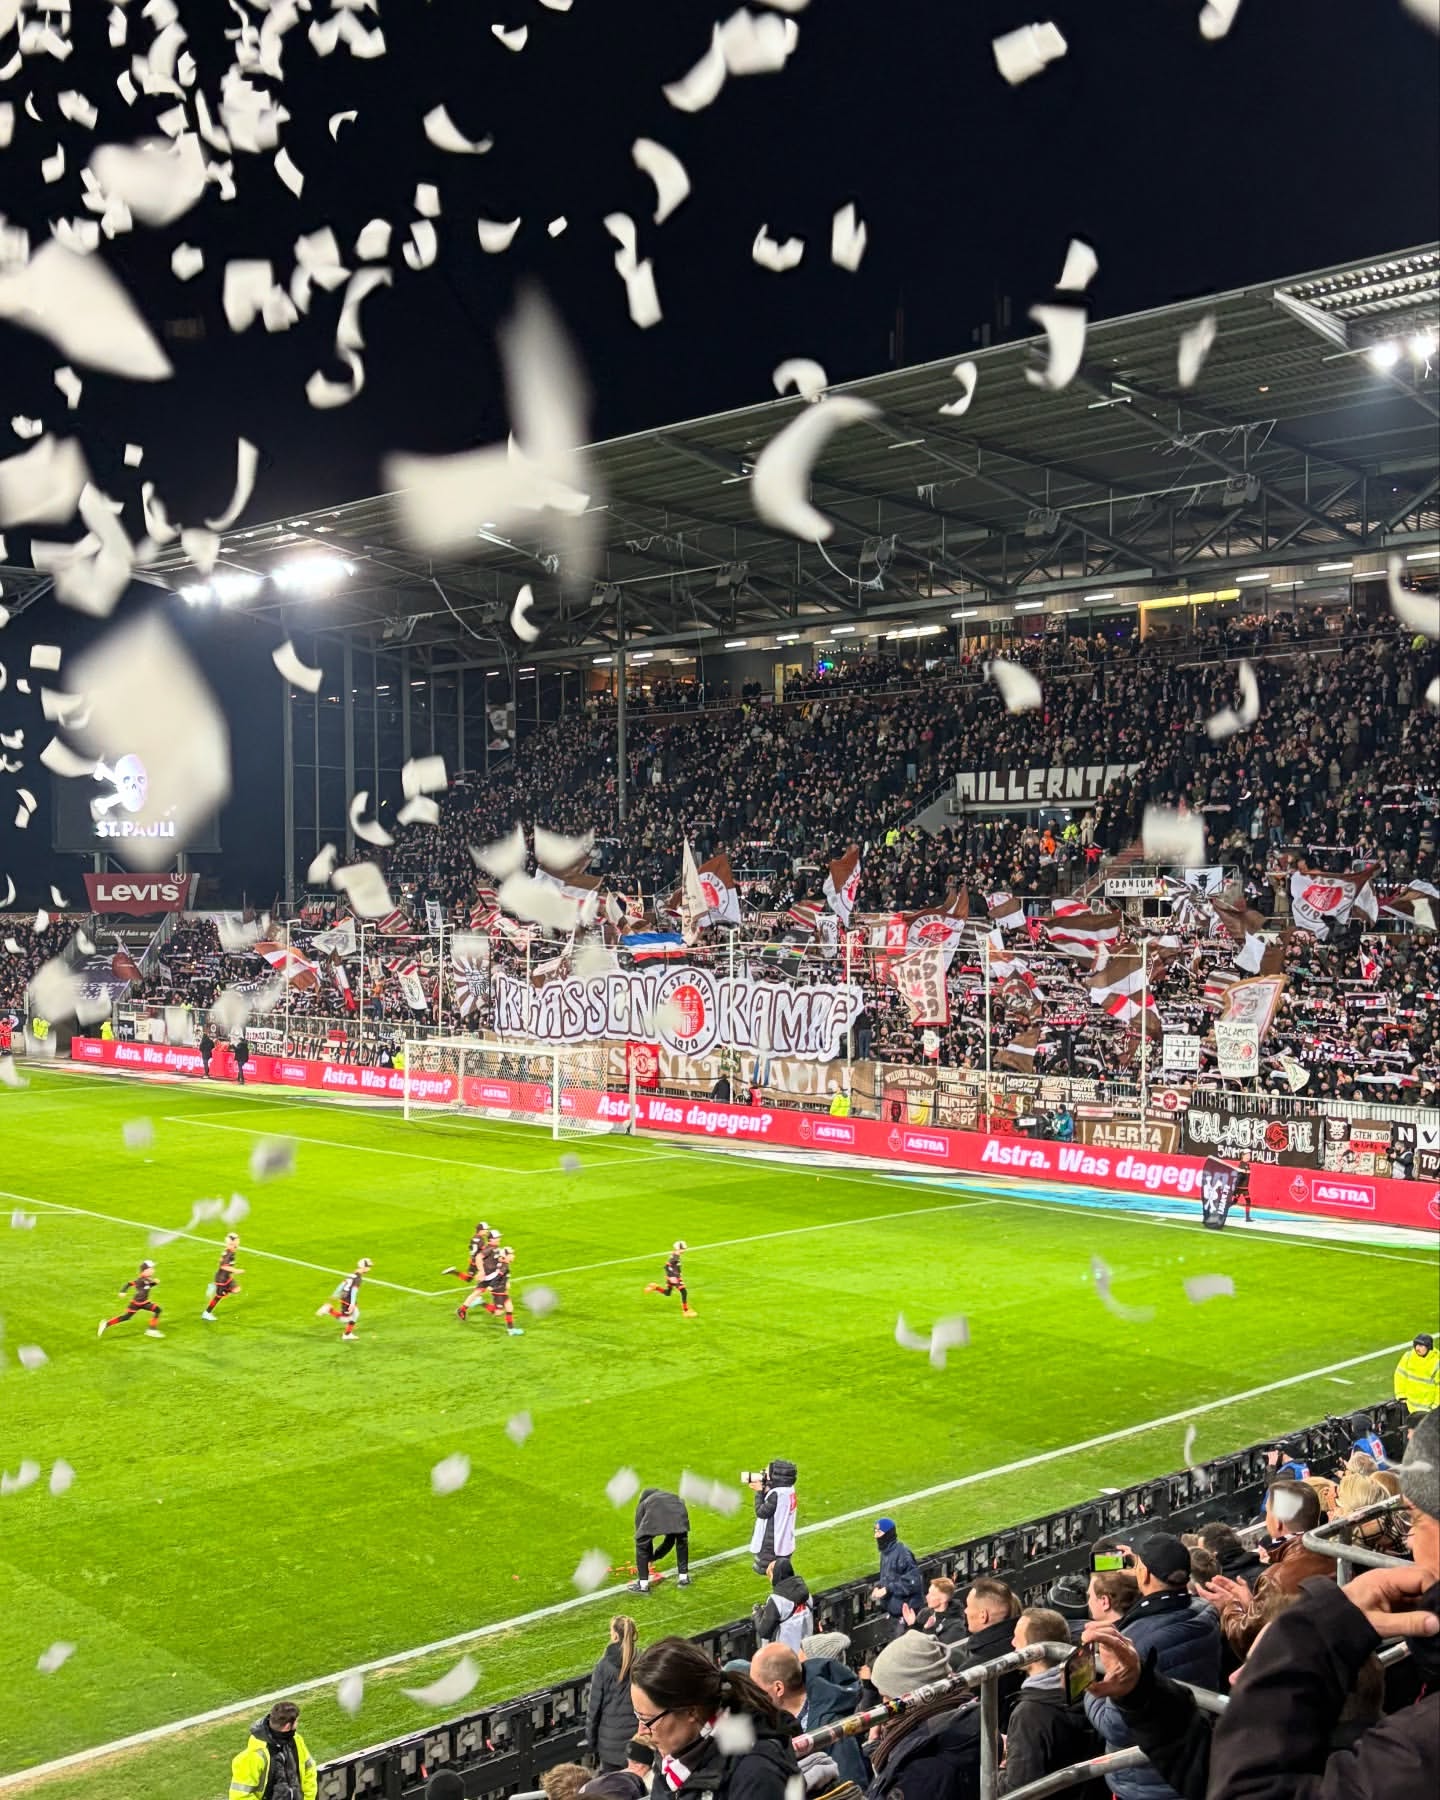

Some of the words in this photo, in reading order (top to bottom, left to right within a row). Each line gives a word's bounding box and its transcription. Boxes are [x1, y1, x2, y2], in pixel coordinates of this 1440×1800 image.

[955, 763, 1142, 800] MILLERNT
[497, 974, 658, 1039] KLASSEN
[674, 1037, 699, 1051] 1910
[115, 1045, 142, 1061] Astra.
[143, 1048, 164, 1064] Was
[165, 1050, 212, 1070] dagege
[323, 1066, 358, 1085] Astra.
[361, 1069, 386, 1089] Was
[483, 1088, 508, 1099] ASTRA
[546, 1096, 573, 1107] ARA
[649, 1101, 683, 1123] Was
[687, 1105, 773, 1134] dagegen?
[816, 1127, 852, 1140] ASTRA
[1092, 1124, 1162, 1144] ALERTA
[907, 1138, 945, 1152] ASTRA
[982, 1140, 1050, 1169] Astra.
[1058, 1147, 1110, 1176] Was
[1317, 1186, 1370, 1203] ASTRA
